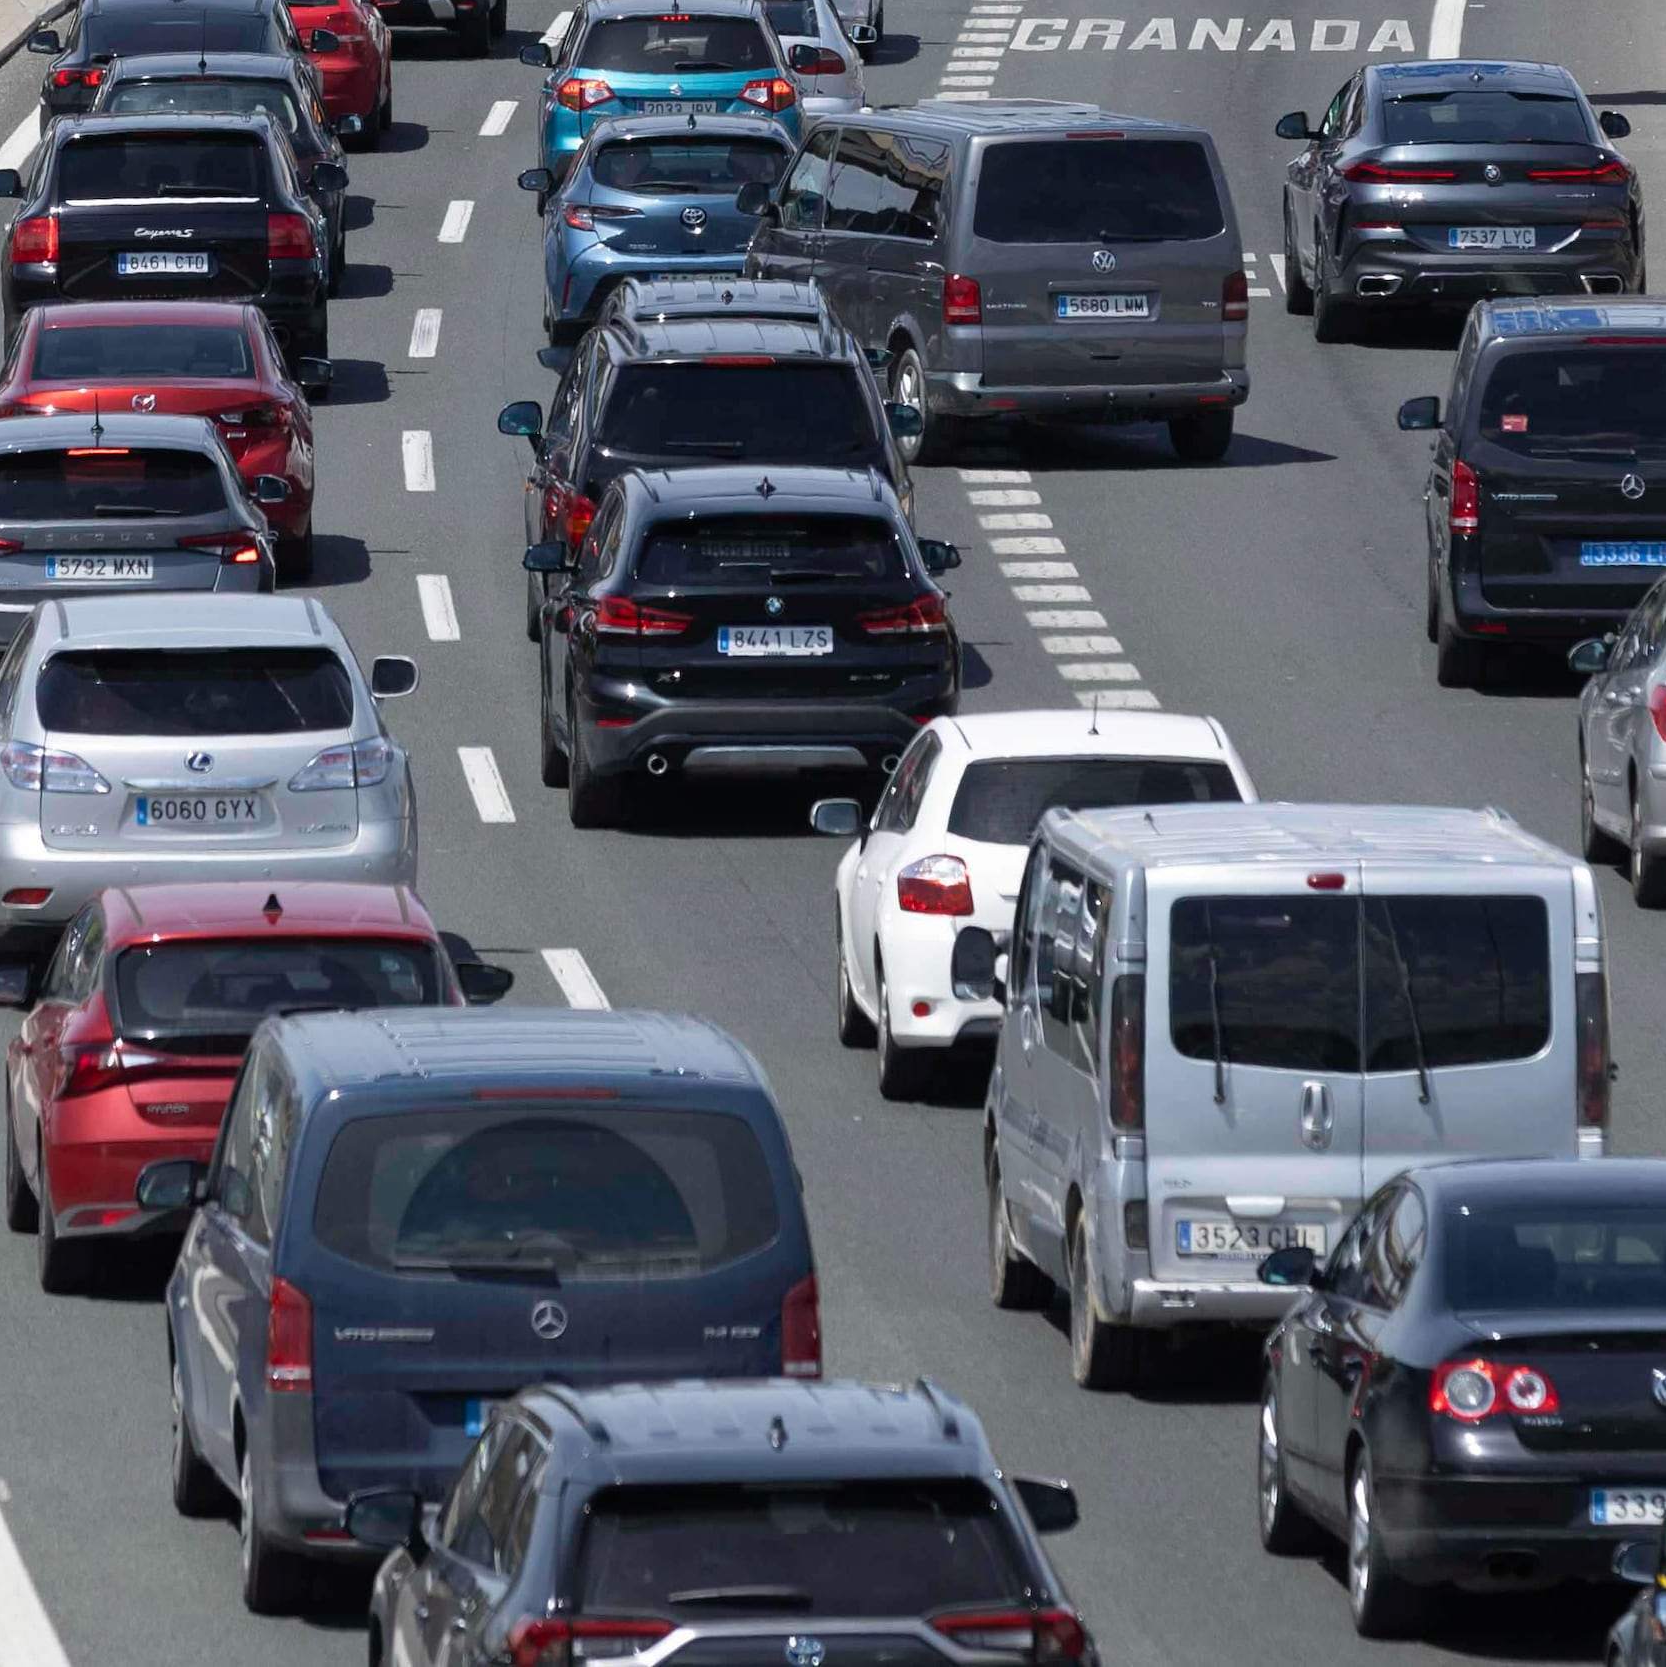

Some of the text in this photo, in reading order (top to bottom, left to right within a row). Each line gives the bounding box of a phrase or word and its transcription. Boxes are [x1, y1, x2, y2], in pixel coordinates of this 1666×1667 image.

[1009, 17, 1416, 53] GRANADA
[1460, 229, 1532, 244] 7537 LYC
[130, 255, 205, 271] 8461 CTD
[1070, 297, 1145, 313] 5680 LMM
[1594, 546, 1641, 563] 3336
[59, 558, 149, 576] 5792 MXN
[734, 630, 828, 649] 8441 LZS
[150, 799, 256, 820] 6060 GYX
[1197, 1227, 1260, 1250] 3523
